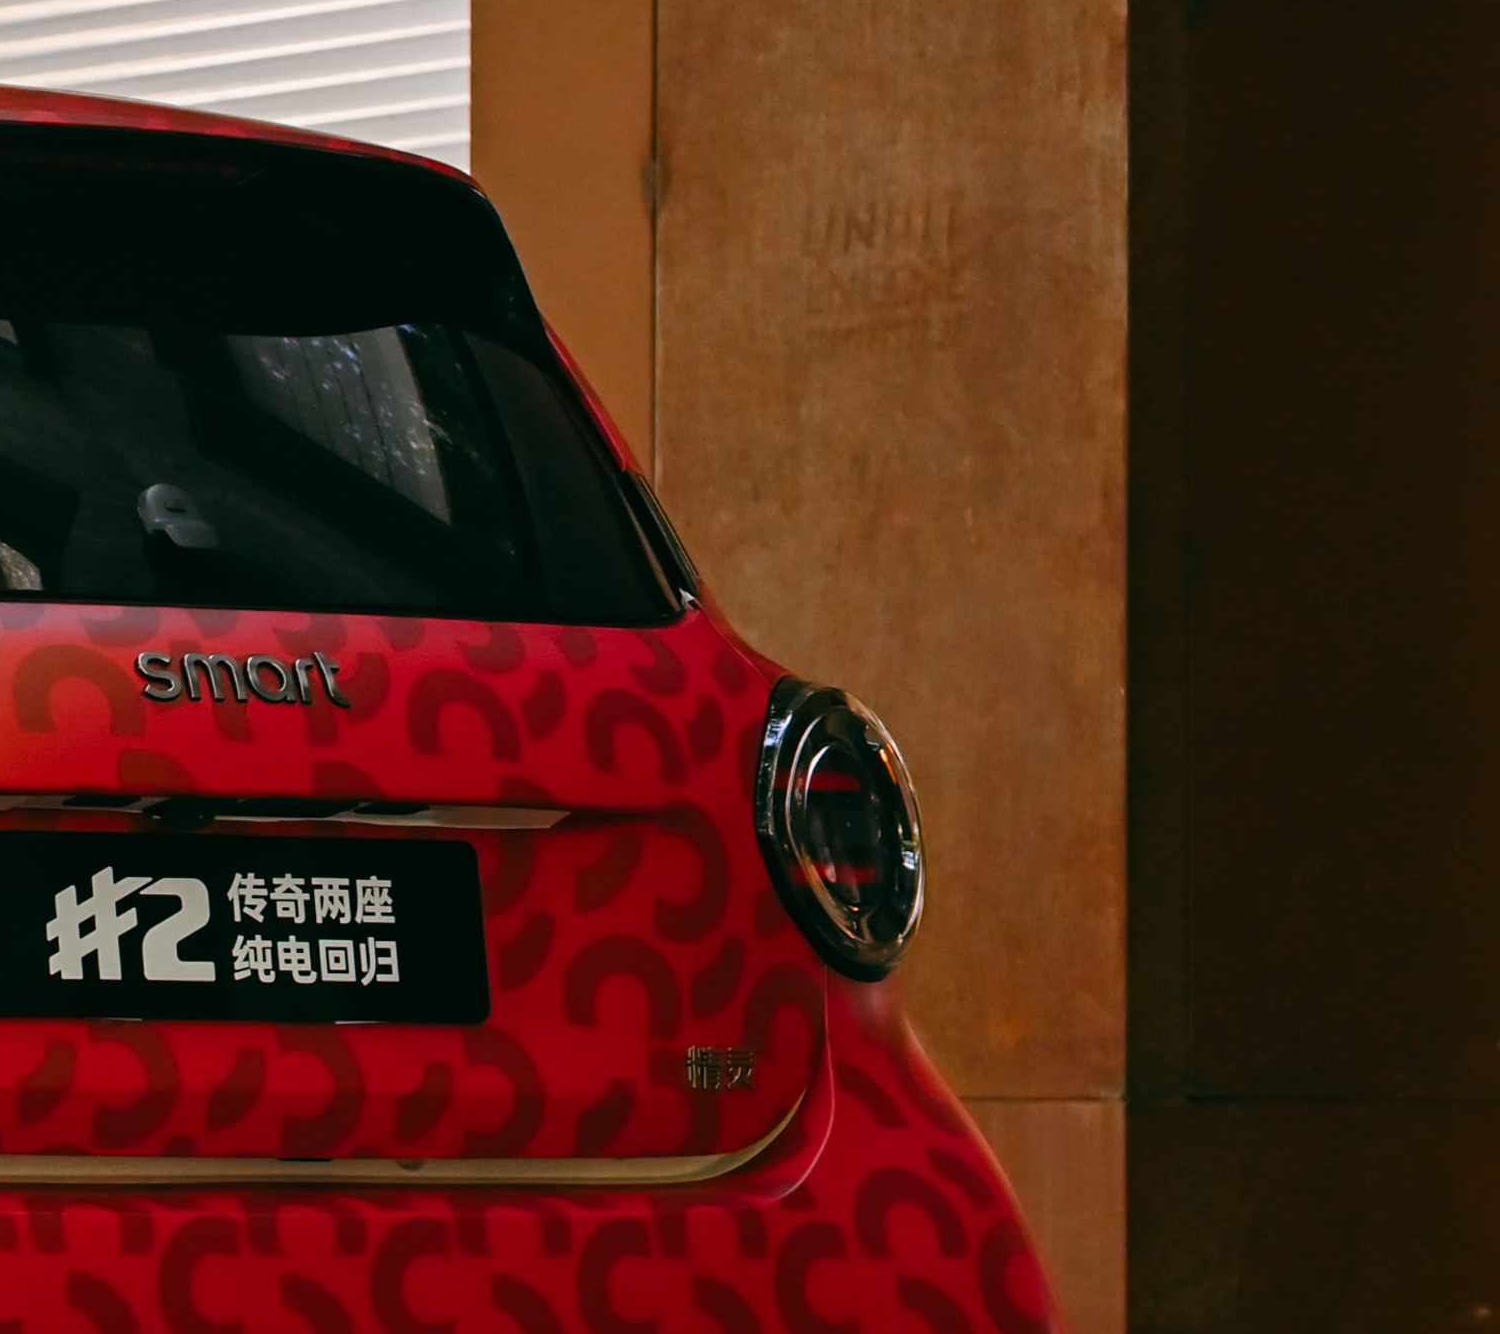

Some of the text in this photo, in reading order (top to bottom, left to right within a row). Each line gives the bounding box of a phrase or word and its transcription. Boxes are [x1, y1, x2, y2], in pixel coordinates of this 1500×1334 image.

[135, 650, 351, 709] smart
[45, 866, 217, 982] #2
[226, 872, 397, 927] 传奇两座
[231, 934, 401, 987] 纯电回归
